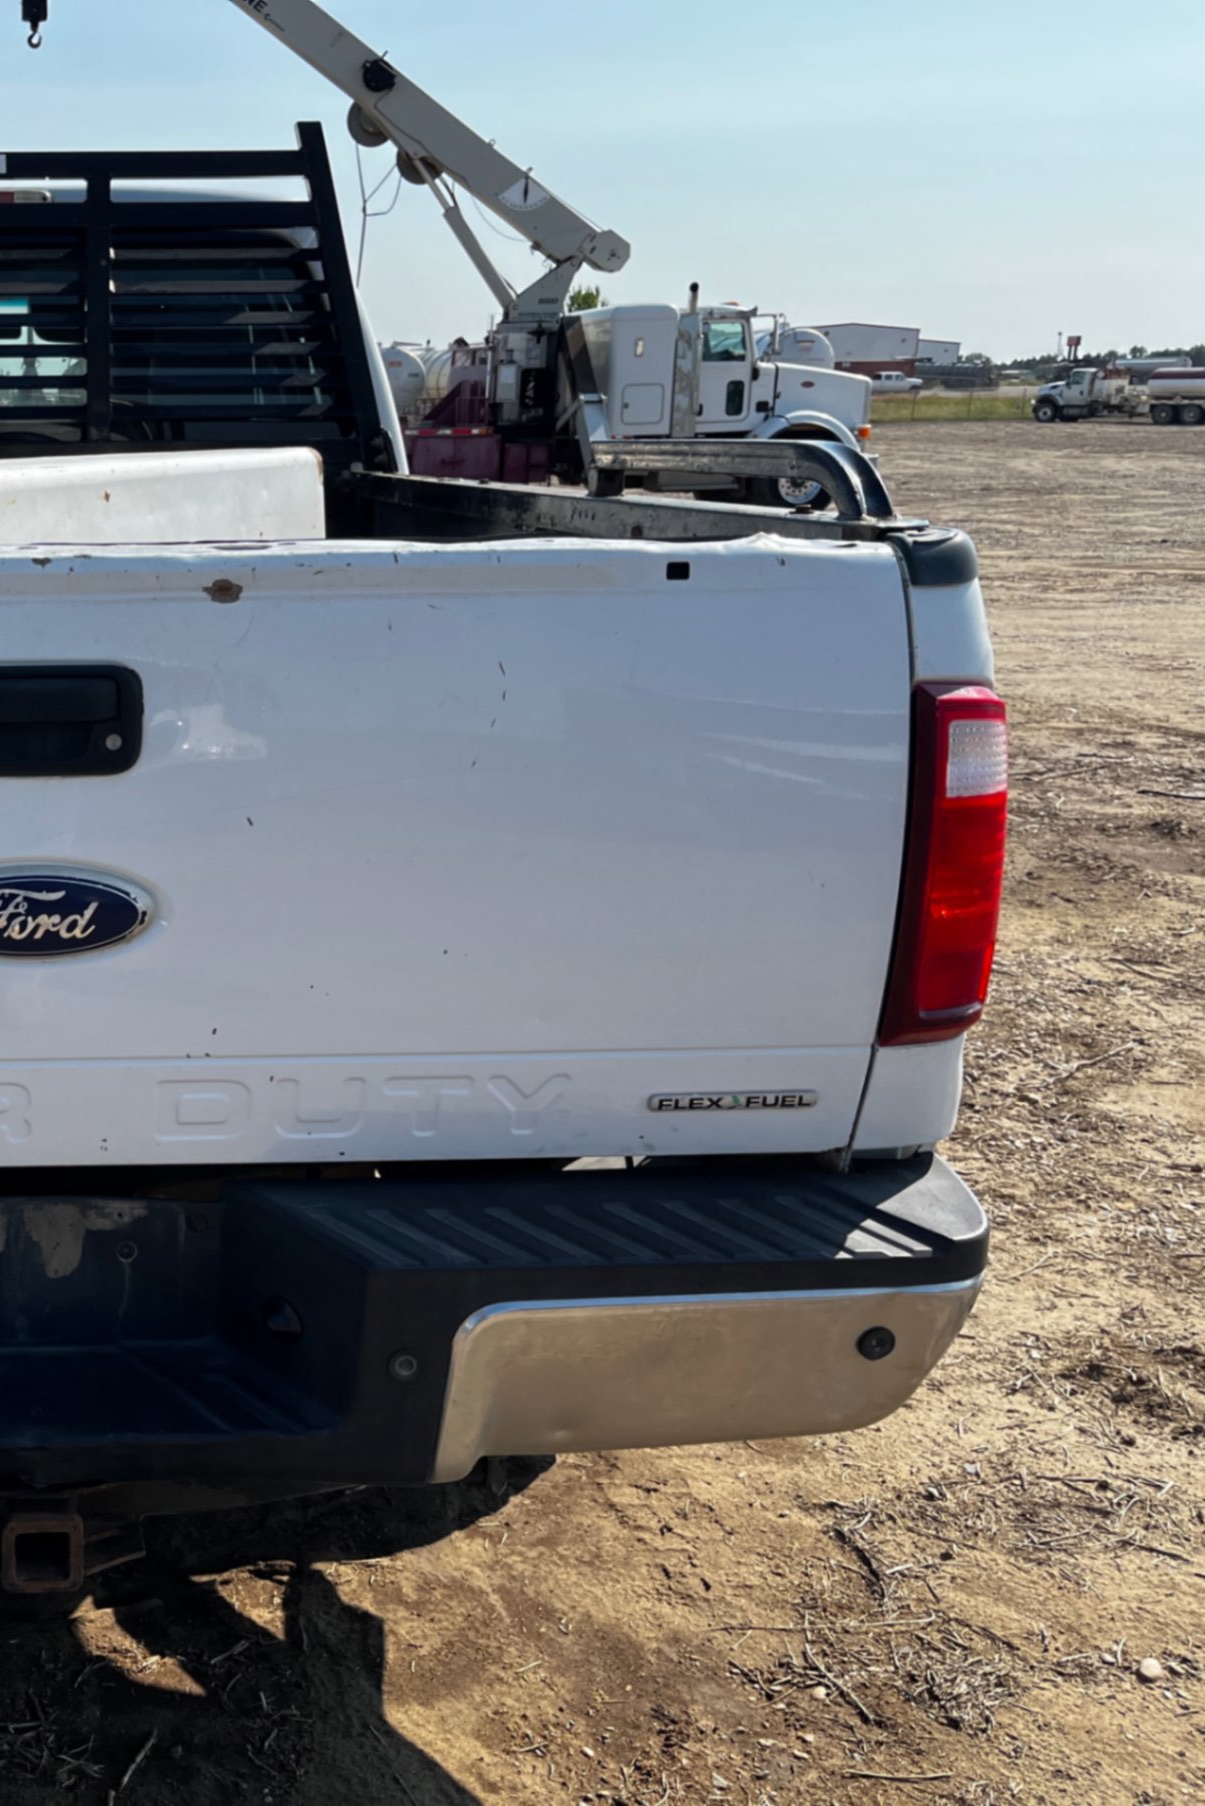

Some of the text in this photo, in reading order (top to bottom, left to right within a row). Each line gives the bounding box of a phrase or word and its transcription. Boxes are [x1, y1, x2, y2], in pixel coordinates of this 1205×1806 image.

[154, 1072, 572, 1141] DUTY
[657, 1094, 812, 1111] FLEX FUEL
